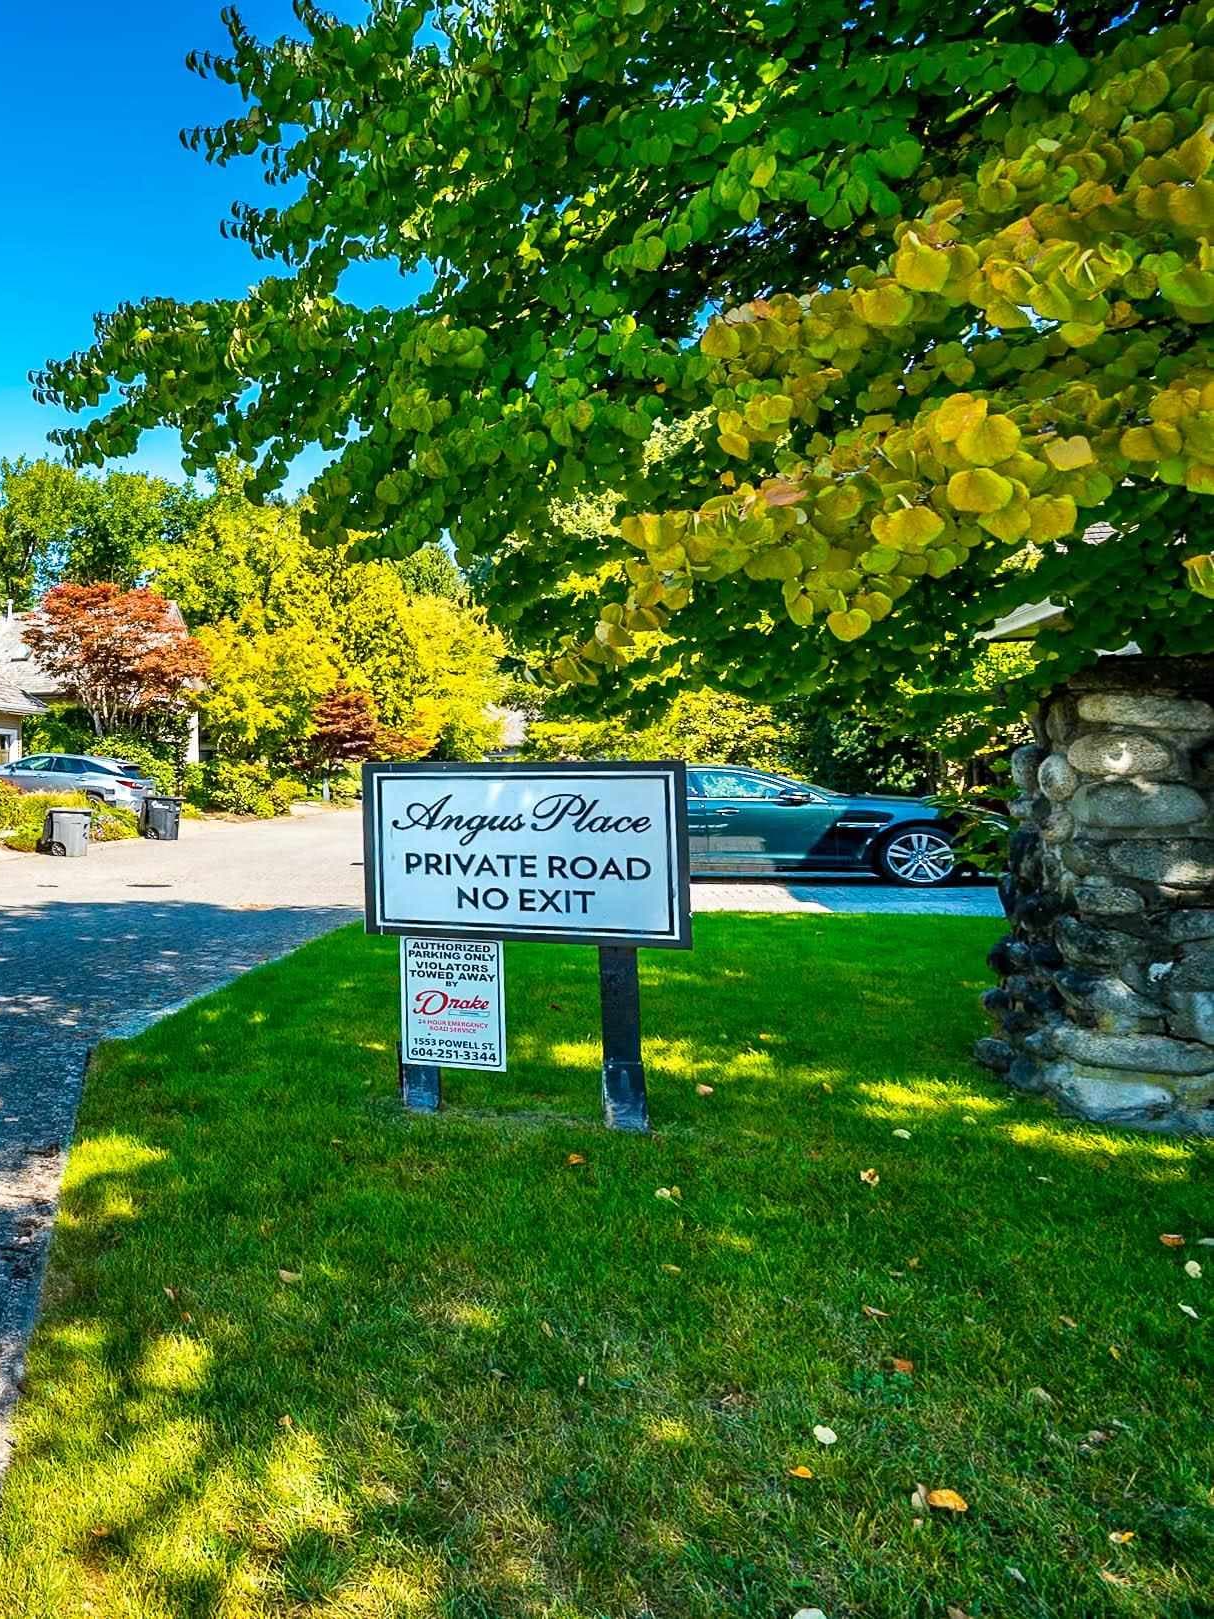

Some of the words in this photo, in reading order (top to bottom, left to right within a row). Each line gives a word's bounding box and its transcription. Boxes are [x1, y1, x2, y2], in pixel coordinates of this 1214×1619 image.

[391, 793, 526, 847] Angus
[531, 793, 652, 833] Place
[404, 852, 537, 878] PRIVATE
[548, 856, 652, 881] ROAD
[457, 886, 509, 911] NO
[518, 889, 596, 914] EXIT
[412, 942, 491, 953] AUTHORIZED
[408, 950, 461, 960] PARKING
[464, 952, 496, 962] ONLY
[415, 961, 489, 973] VIOLATORS
[409, 969, 454, 980] TOWED
[458, 972, 496, 983] AWAY
[412, 989, 490, 1016] Drake
[413, 1037, 437, 1046] 1553
[438, 1039, 481, 1050] POWELL
[481, 1042, 495, 1051] ST.
[411, 1047, 497, 1062] 604-251-3344
